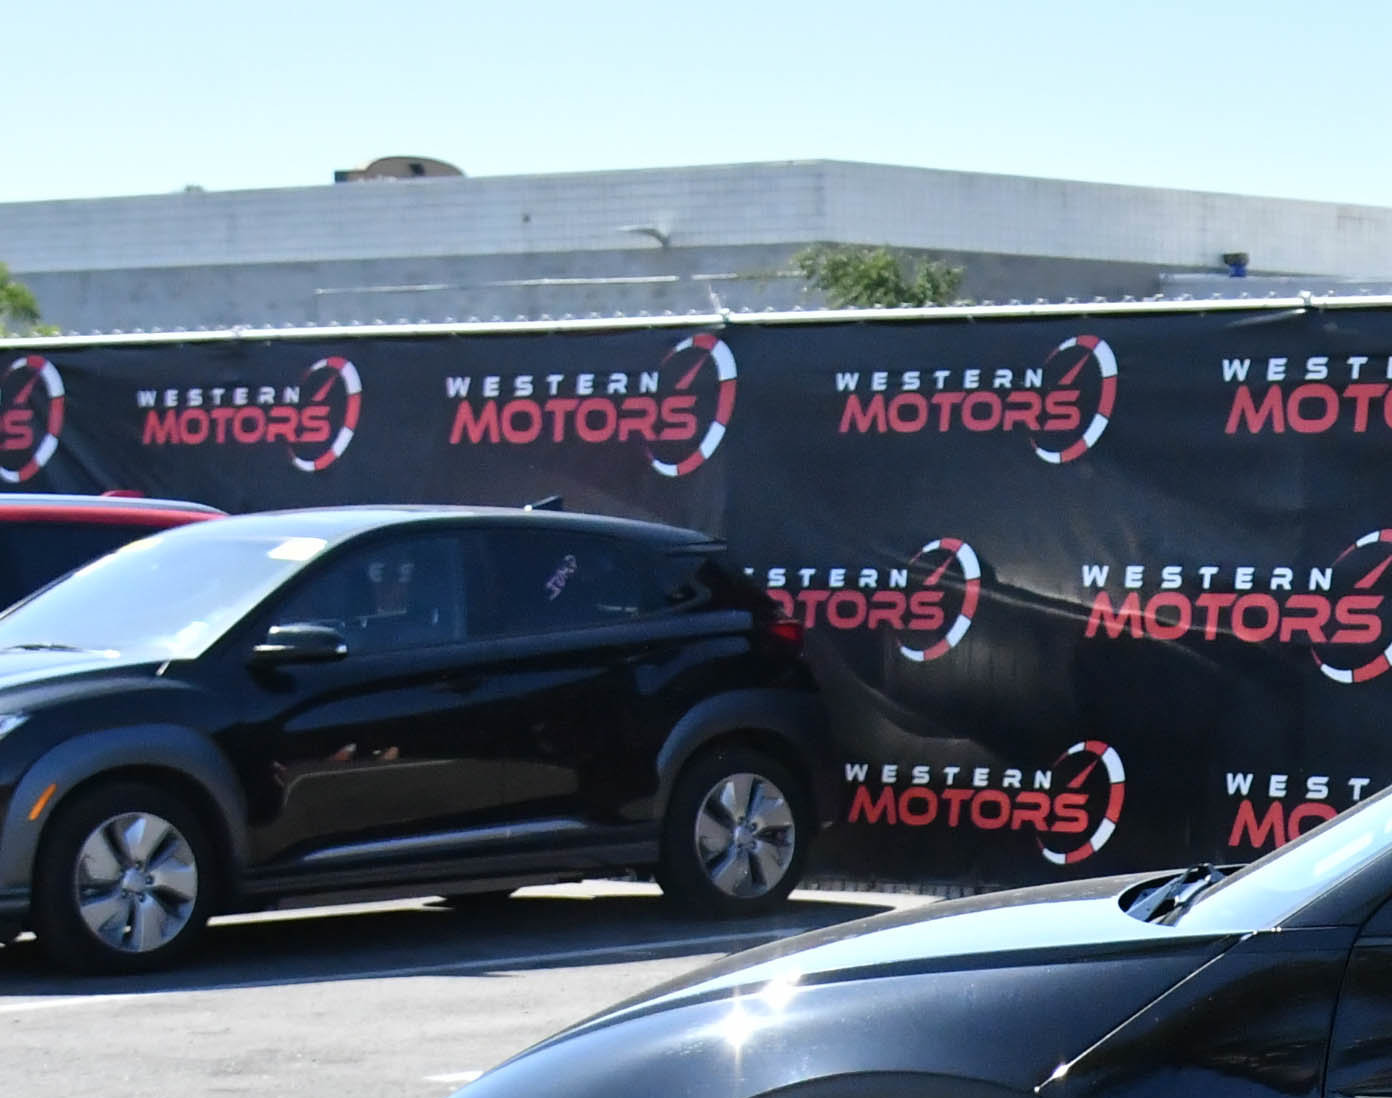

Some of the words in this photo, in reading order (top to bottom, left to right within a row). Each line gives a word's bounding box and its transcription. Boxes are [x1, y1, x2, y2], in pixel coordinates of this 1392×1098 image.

[446, 371, 659, 398] WESTERN
[835, 368, 1043, 392] WESTERN
[137, 386, 300, 408] WESTERN
[839, 389, 1081, 433] MOTORS
[143, 404, 332, 445] MOTORS
[449, 394, 697, 445] MOTORS
[744, 567, 908, 588] STERN
[1081, 564, 1333, 591] WESTERN
[767, 589, 945, 631] TORS
[1084, 591, 1384, 644] MOTORS
[845, 763, 1052, 790] WESTERN
[1226, 772, 1371, 801] WEST
[848, 784, 1089, 834] MOTORS
